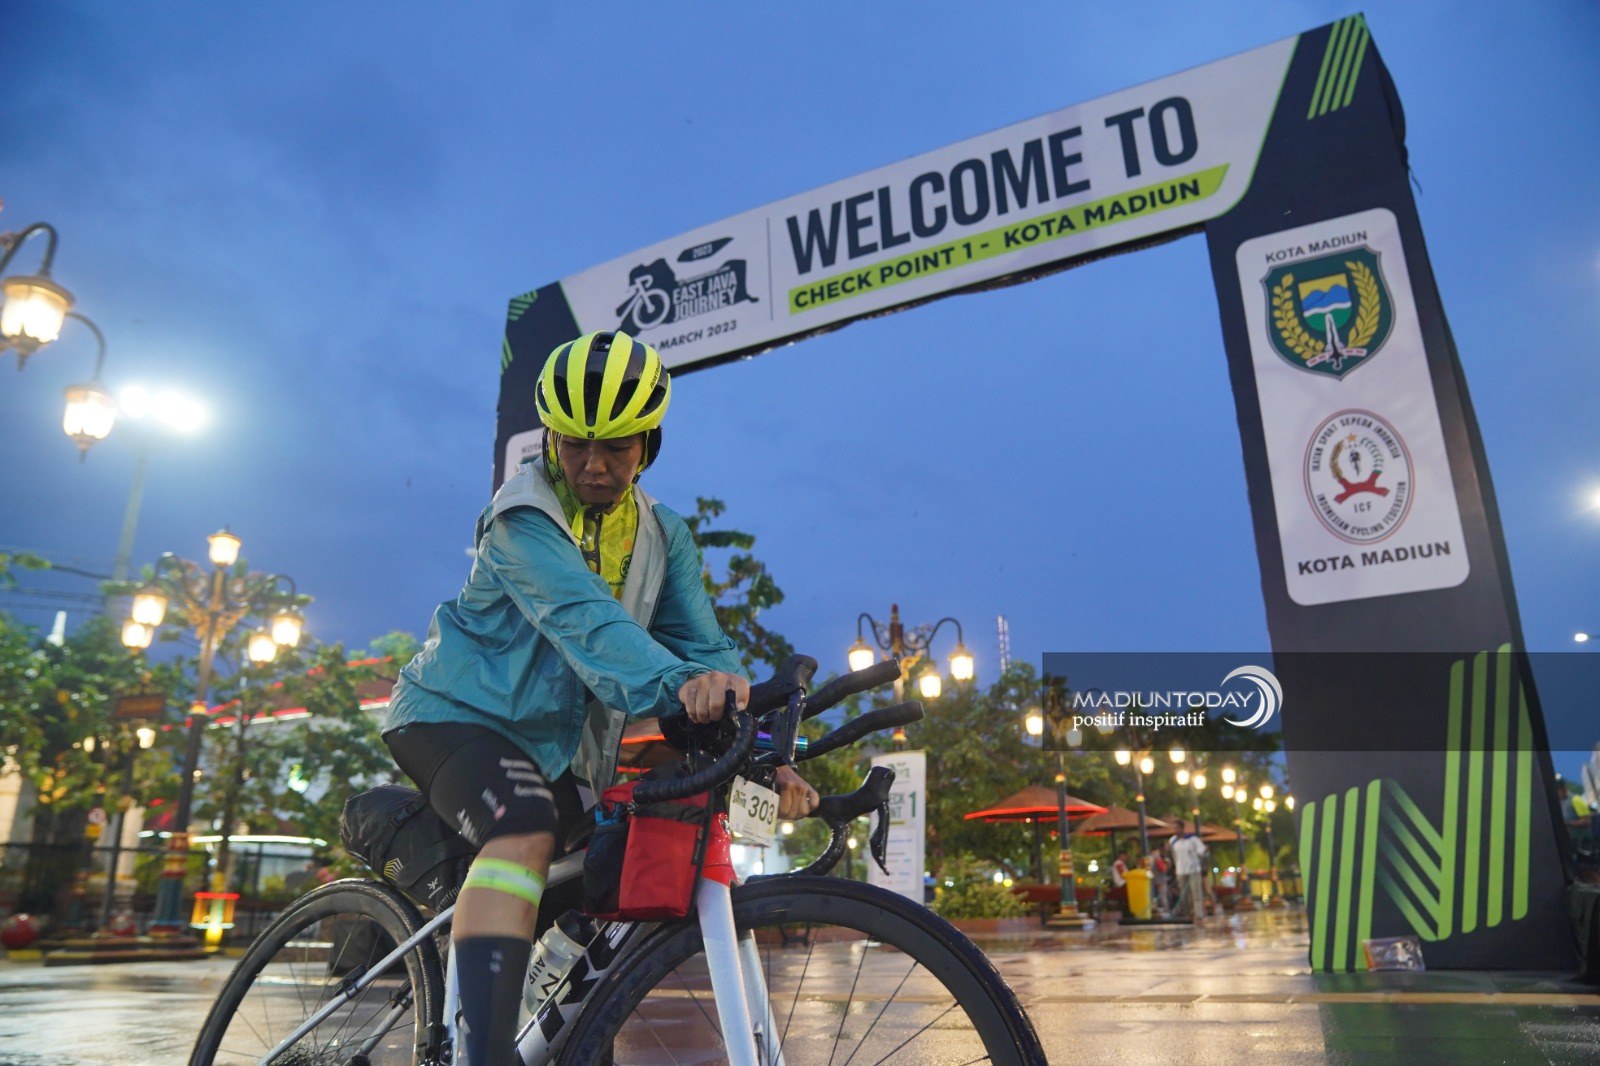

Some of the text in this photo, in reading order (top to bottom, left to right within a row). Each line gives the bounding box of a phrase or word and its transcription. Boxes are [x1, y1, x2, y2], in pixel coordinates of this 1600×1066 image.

[786, 96, 1199, 274] WELCOME TO
[794, 271, 873, 309] CHECK
[879, 248, 954, 284] POINT
[961, 242, 973, 260] 1
[1003, 214, 1077, 249] KOTA
[1084, 179, 1200, 227] MADIUN
[1265, 230, 1368, 264] KOTA MADIUN
[672, 280, 705, 306] EAST
[707, 270, 738, 296] JAVA
[673, 287, 738, 323] JOURNEY
[659, 319, 738, 350] MARCH 2023
[1353, 501, 1373, 514] ICF
[1298, 540, 1451, 576] KOTA MADIUN
[748, 795, 775, 826] 303
